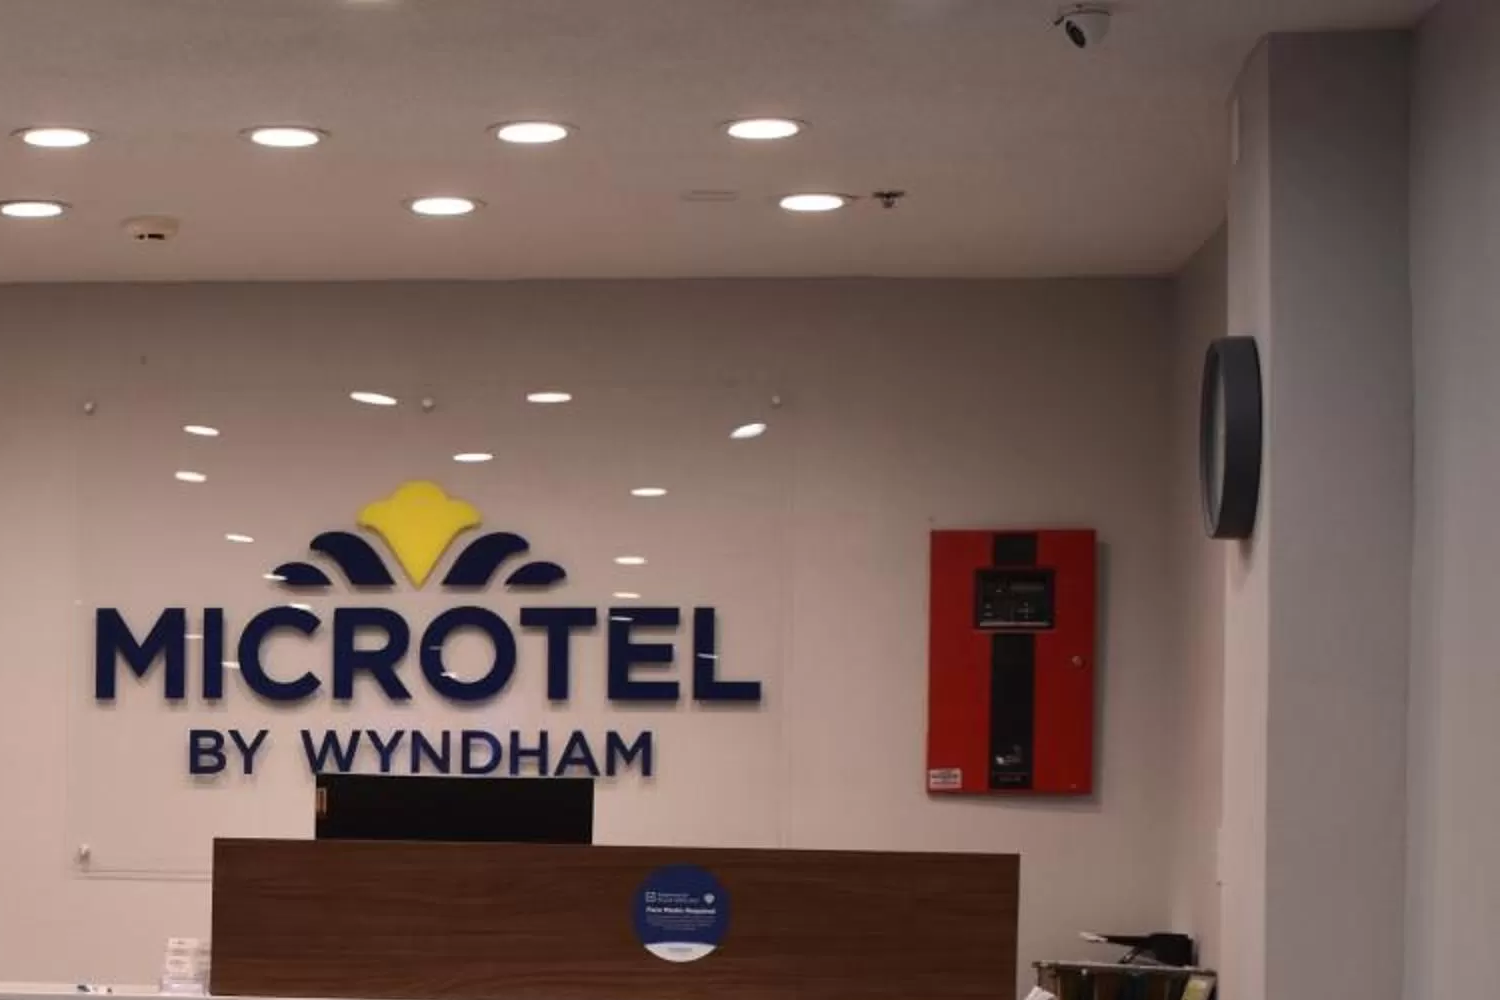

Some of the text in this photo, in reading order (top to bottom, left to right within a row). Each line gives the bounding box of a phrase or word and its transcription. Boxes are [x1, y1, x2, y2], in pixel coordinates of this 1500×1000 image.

[95, 605, 762, 702] MICROTEL
[189, 729, 653, 777] BY WYNDHAM
